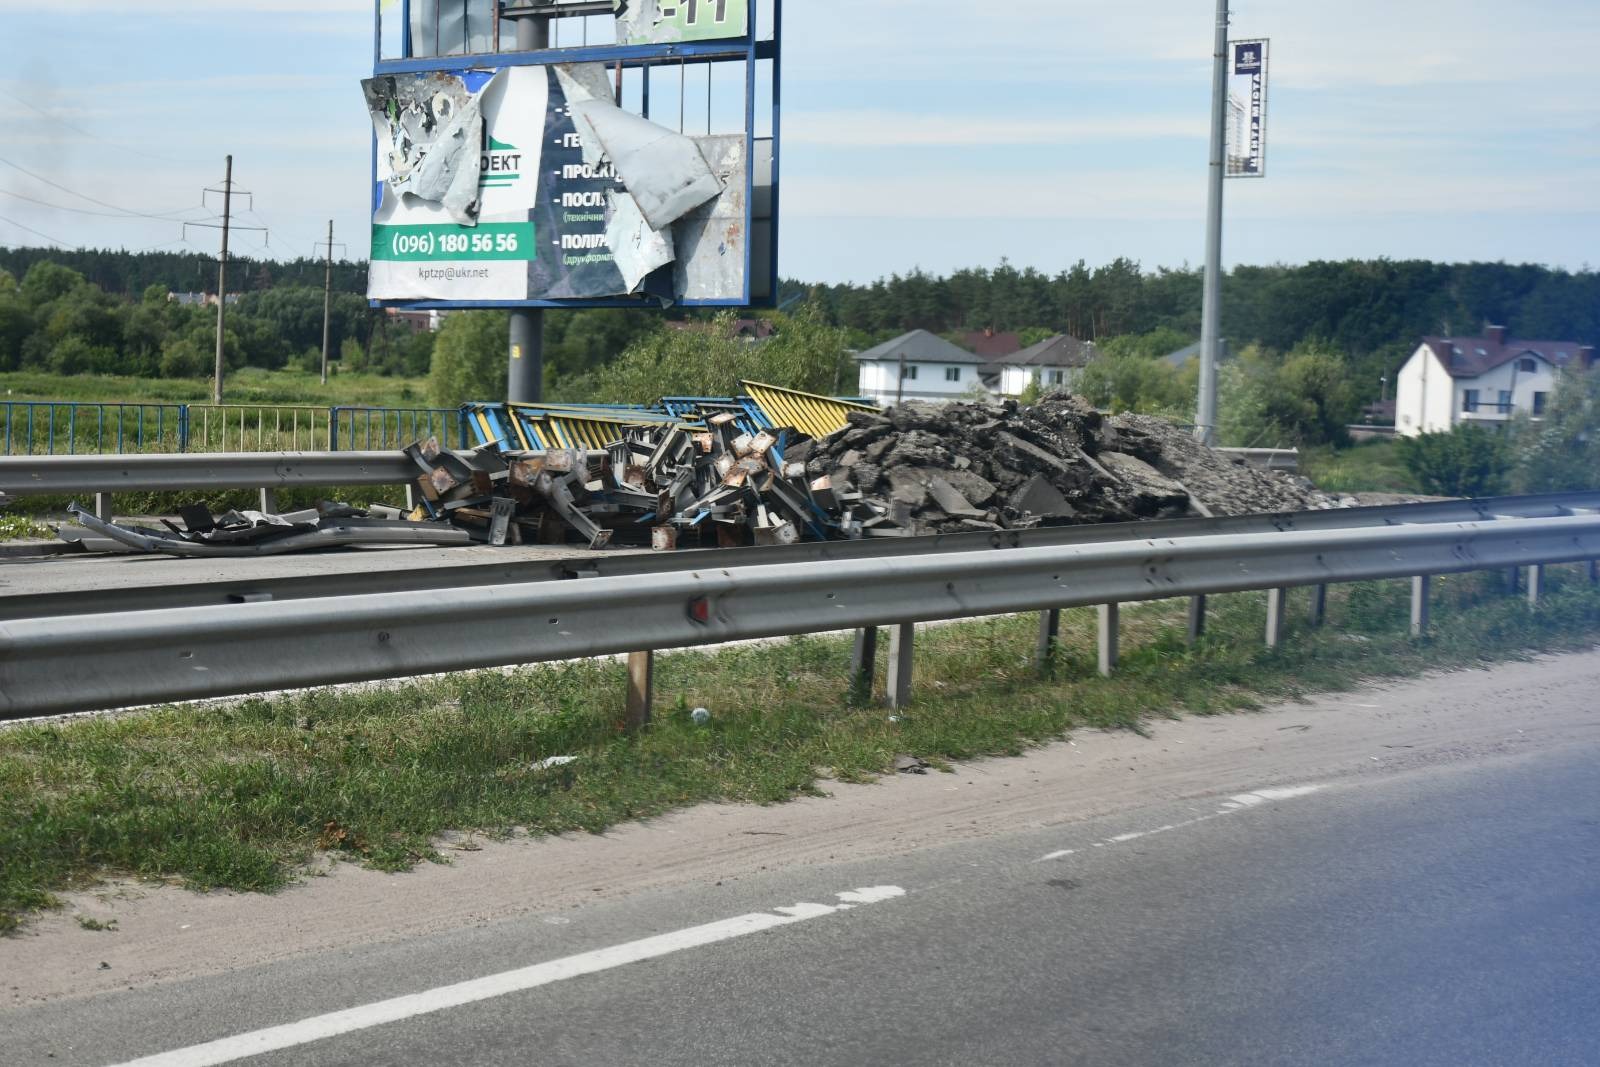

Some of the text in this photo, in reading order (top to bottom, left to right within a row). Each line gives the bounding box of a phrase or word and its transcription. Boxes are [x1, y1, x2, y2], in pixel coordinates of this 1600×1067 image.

[393, 232, 518, 256] (096) 180 56 56
[418, 268, 489, 280] kptzp@ukr.net
